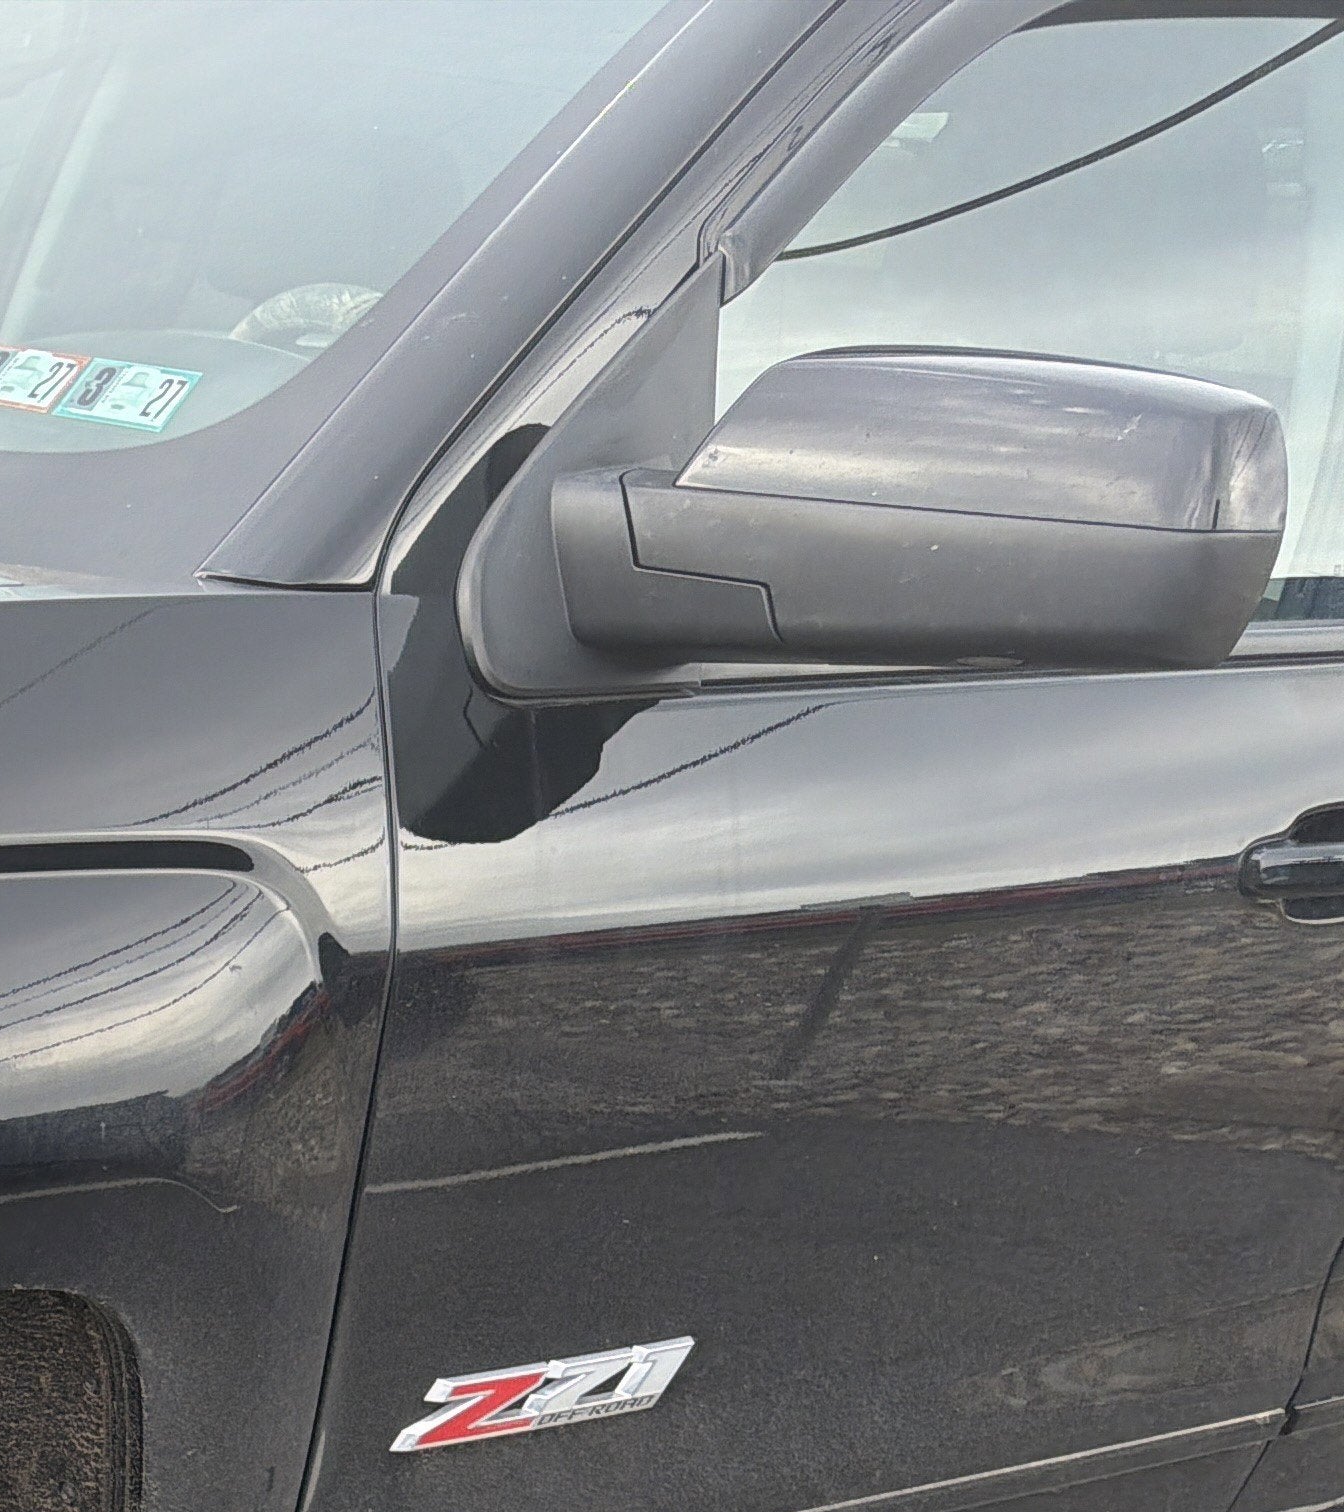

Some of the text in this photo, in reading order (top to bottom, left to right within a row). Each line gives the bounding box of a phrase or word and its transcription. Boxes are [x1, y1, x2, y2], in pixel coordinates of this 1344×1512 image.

[27, 361, 77, 403] 27
[76, 366, 117, 407] 3
[139, 378, 189, 421] 27
[389, 1335, 695, 1453] Z71
